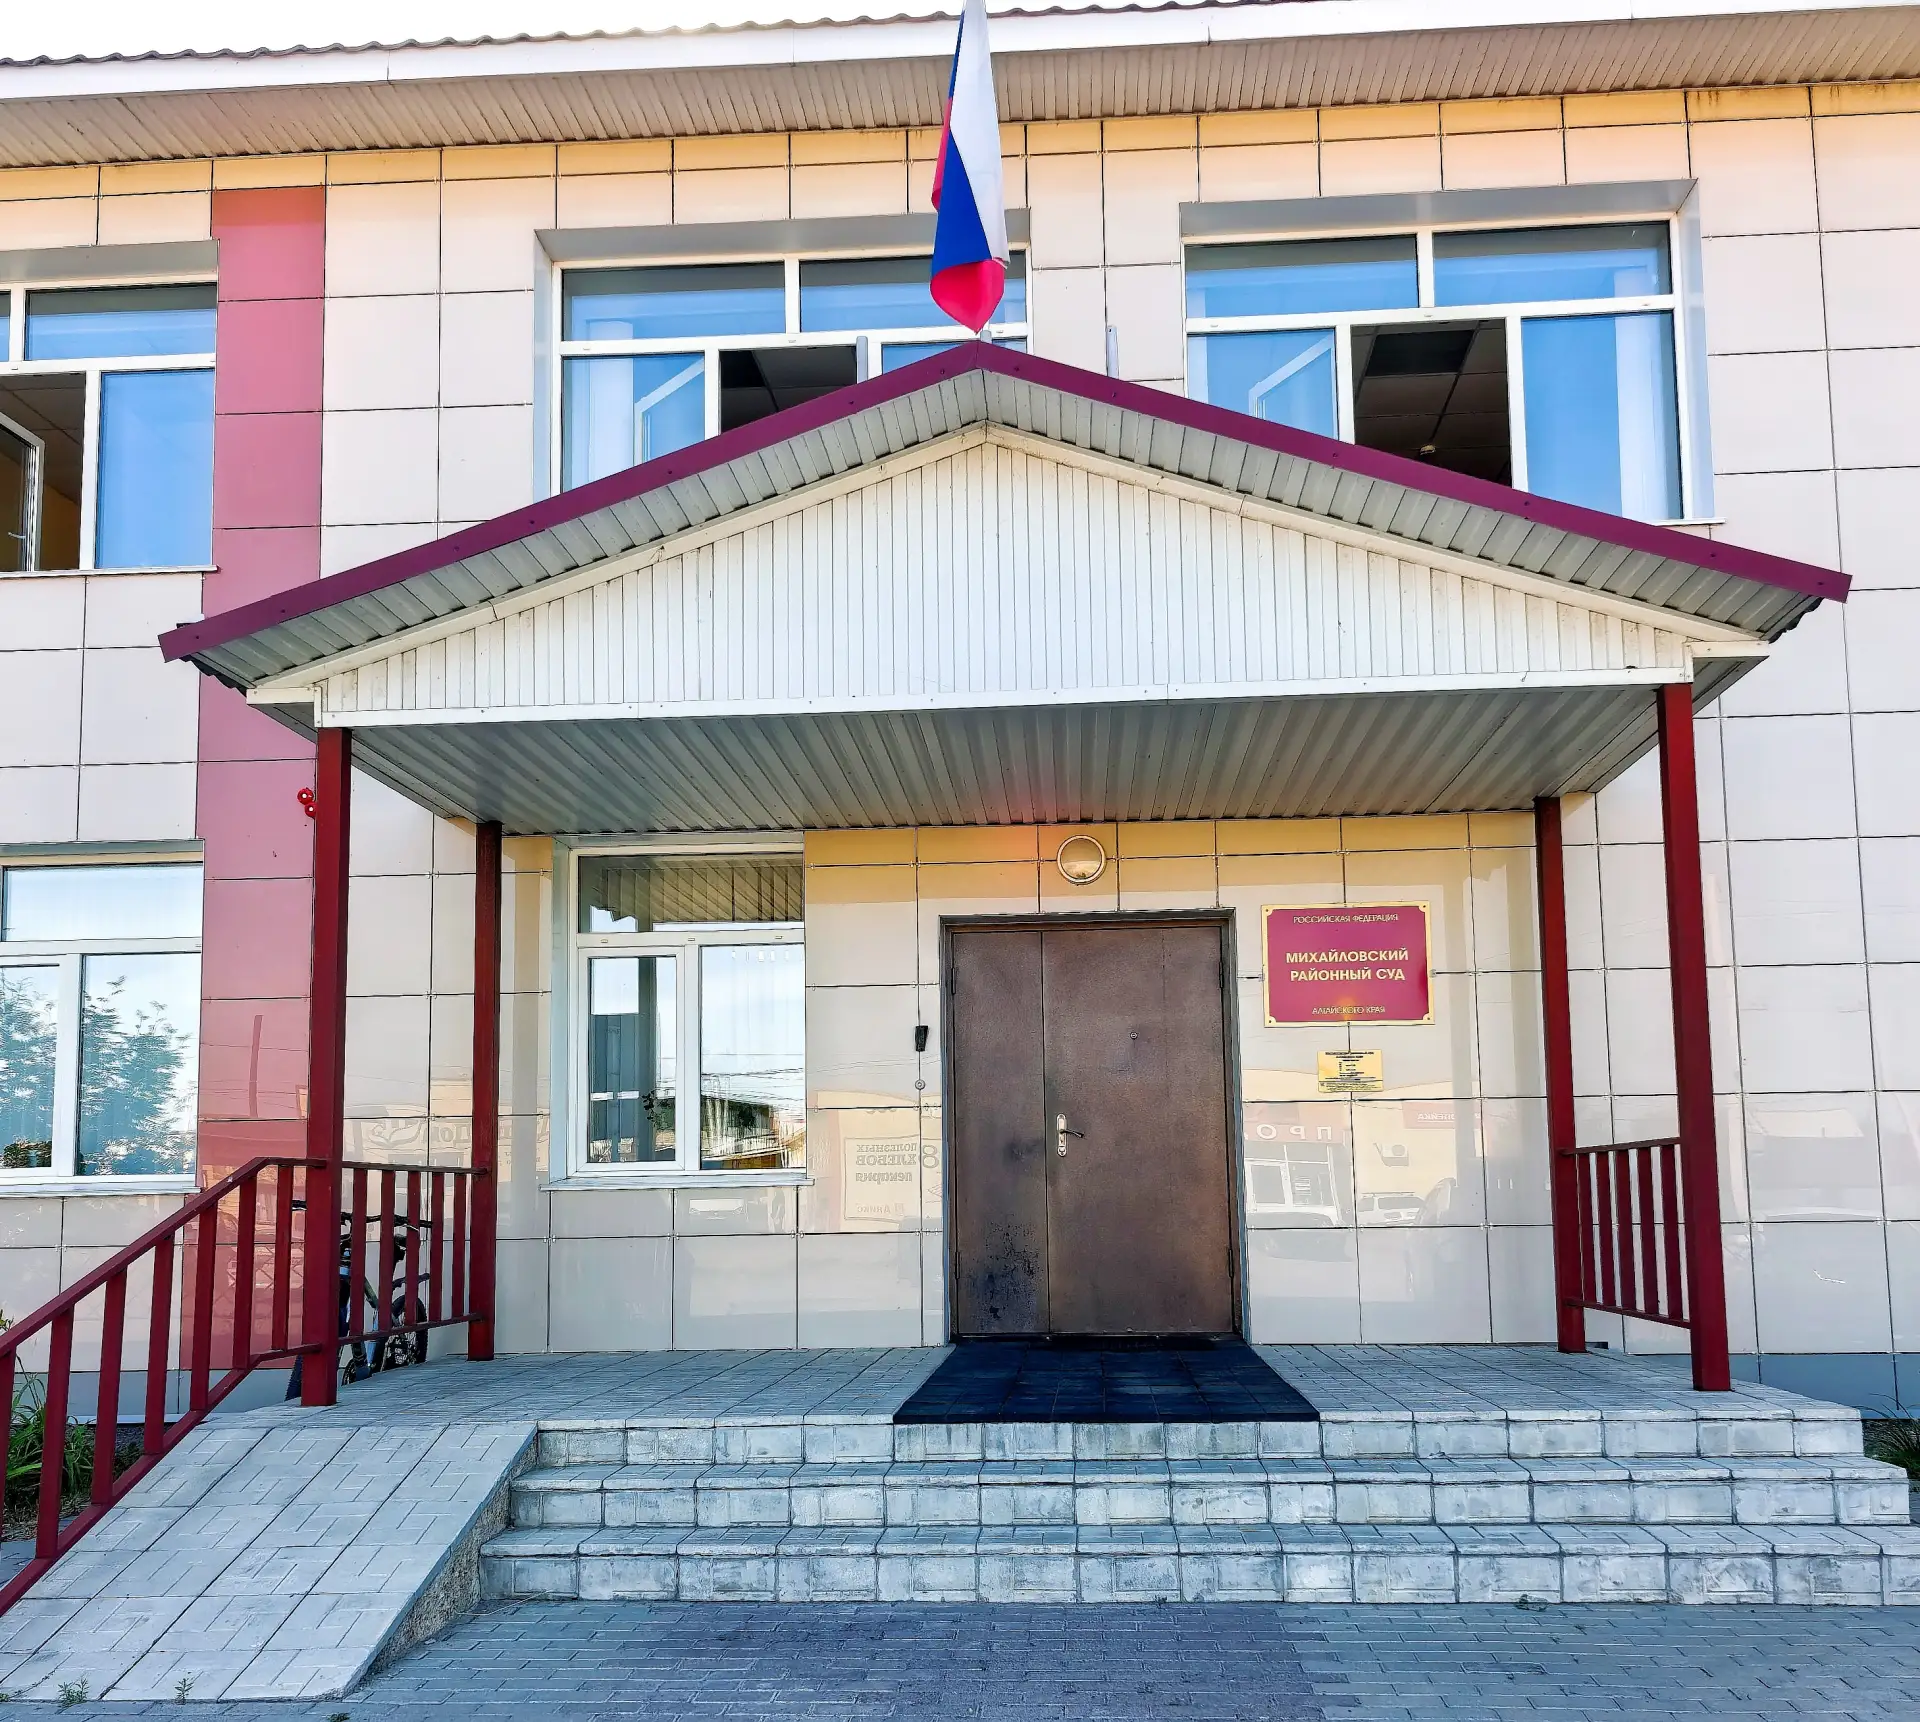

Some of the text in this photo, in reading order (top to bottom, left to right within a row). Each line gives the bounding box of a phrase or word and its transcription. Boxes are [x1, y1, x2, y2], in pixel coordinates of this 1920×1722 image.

[1293, 913, 1399, 924] РОССИЙСКАЯ ФЕДЕРАЦИЯ
[1286, 947, 1409, 963] МИХАЙЛОВСКИЙ
[1290, 967, 1405, 981] РАЙОННЫЙ СУД
[1312, 1005, 1385, 1015] АЛТАЙСКОГО КРАЯ
